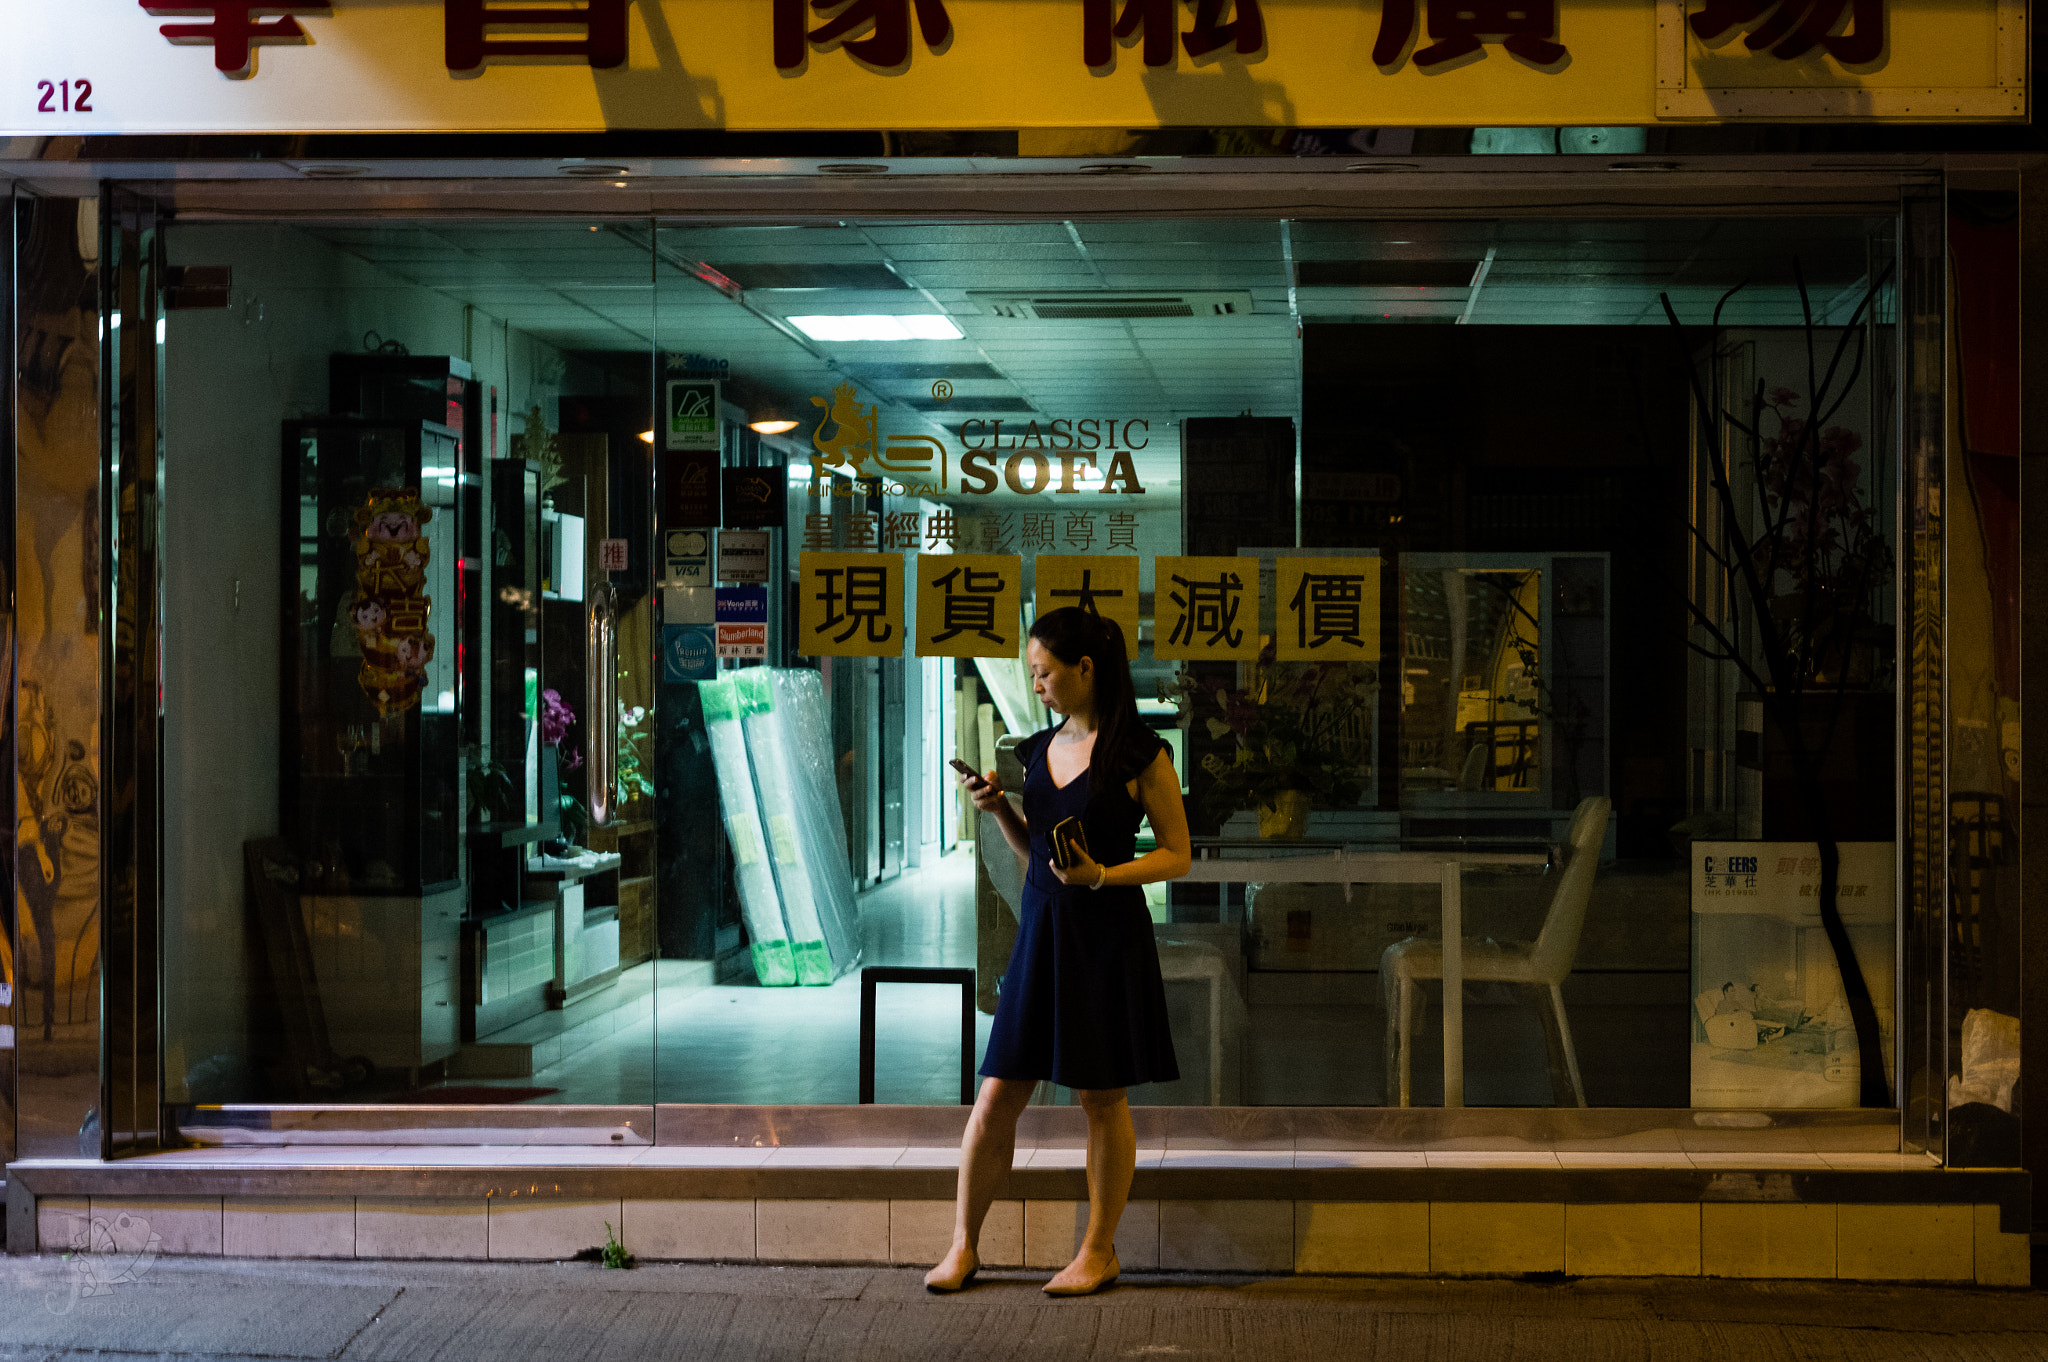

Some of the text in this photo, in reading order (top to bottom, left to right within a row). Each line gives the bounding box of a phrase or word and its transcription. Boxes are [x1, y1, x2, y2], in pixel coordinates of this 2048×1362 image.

[37, 80, 92, 112] 212
[959, 419, 1150, 450] CLASSIC
[959, 450, 1146, 494] SOFA
[807, 482, 947, 498] KING'S ROYAL
[800, 510, 962, 552] 皇室經典
[980, 511, 1140, 552] 彰顯尊貴
[603, 542, 624, 564] 推
[675, 565, 700, 577] VISA
[719, 627, 764, 642] Slumberland
[719, 645, 765, 655] 斯林百蘭
